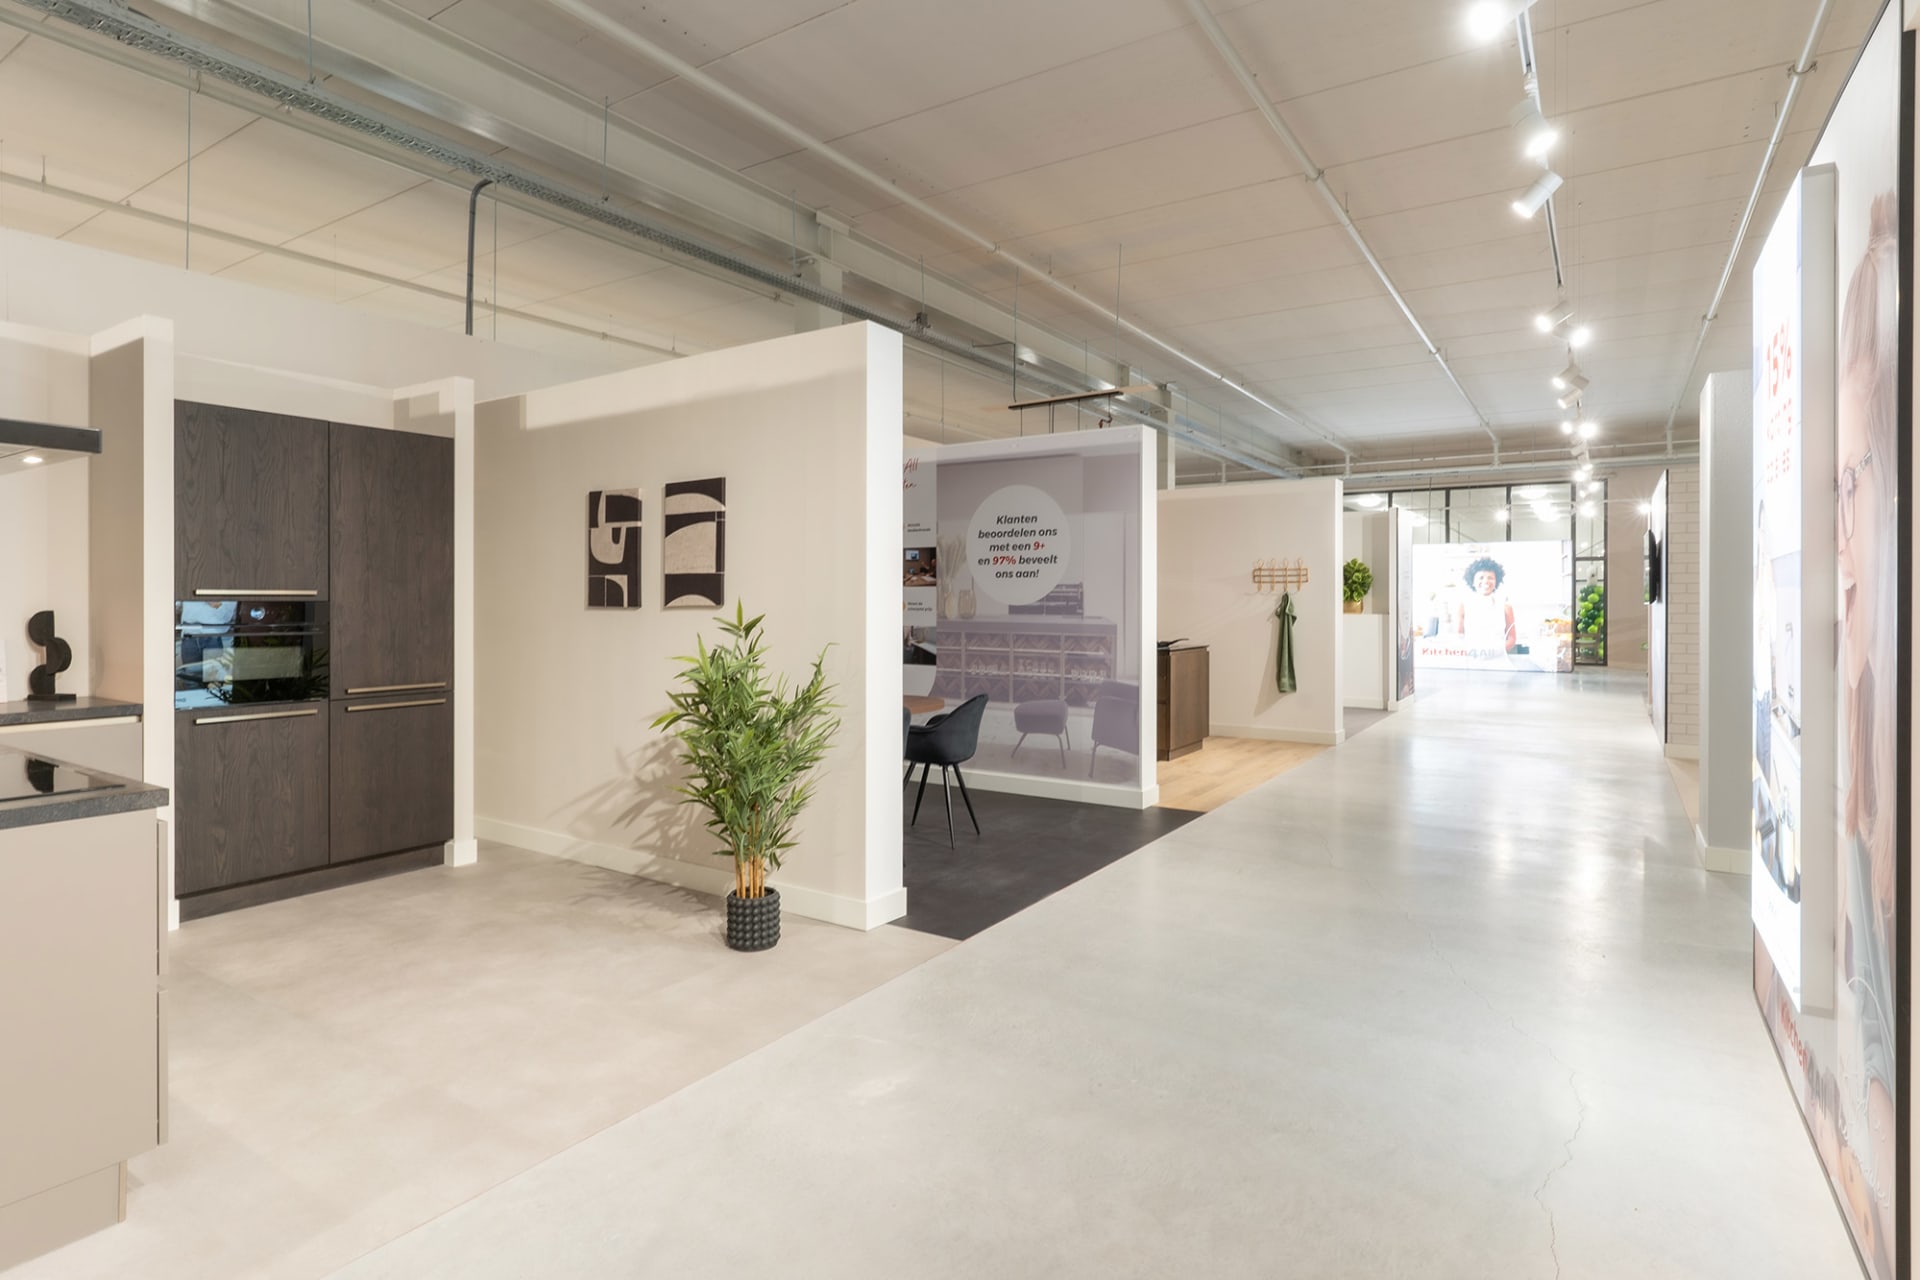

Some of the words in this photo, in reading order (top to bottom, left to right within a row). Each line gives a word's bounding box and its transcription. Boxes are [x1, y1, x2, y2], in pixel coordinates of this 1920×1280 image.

[1766, 318, 1792, 401] 15%
[996, 515, 1038, 525] Klanten
[978, 528, 1036, 539] beoordelen
[1038, 528, 1058, 537] ons
[989, 543, 1010, 552] met
[1012, 543, 1031, 551] een
[1033, 541, 1045, 551] 9+
[977, 557, 990, 565] en
[992, 555, 1017, 565] 97%
[1018, 554, 1058, 565] beveelt
[995, 570, 1014, 578] ons
[1015, 569, 1040, 578] aan!
